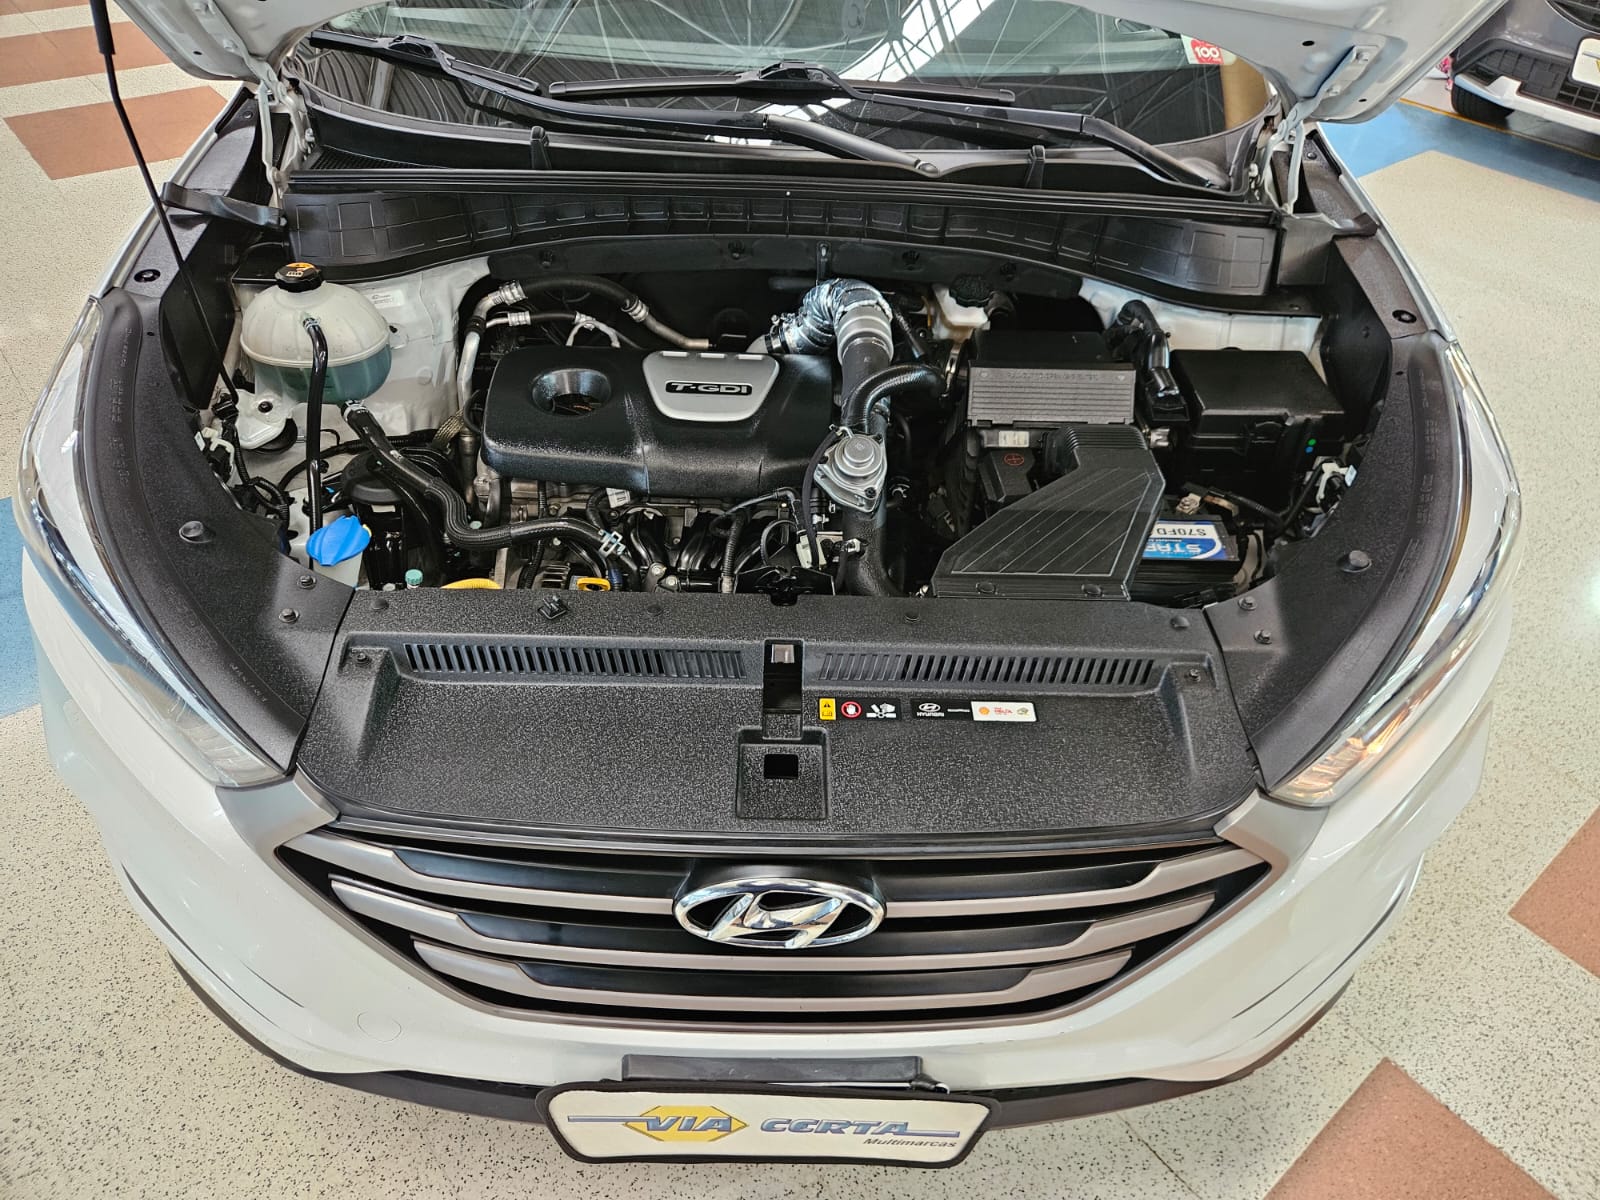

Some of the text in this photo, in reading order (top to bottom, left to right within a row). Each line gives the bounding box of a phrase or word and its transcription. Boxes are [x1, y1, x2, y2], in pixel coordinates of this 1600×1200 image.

[646, 1115, 910, 1136] VIA CERTA
[862, 1137, 958, 1148] Multimarcas
